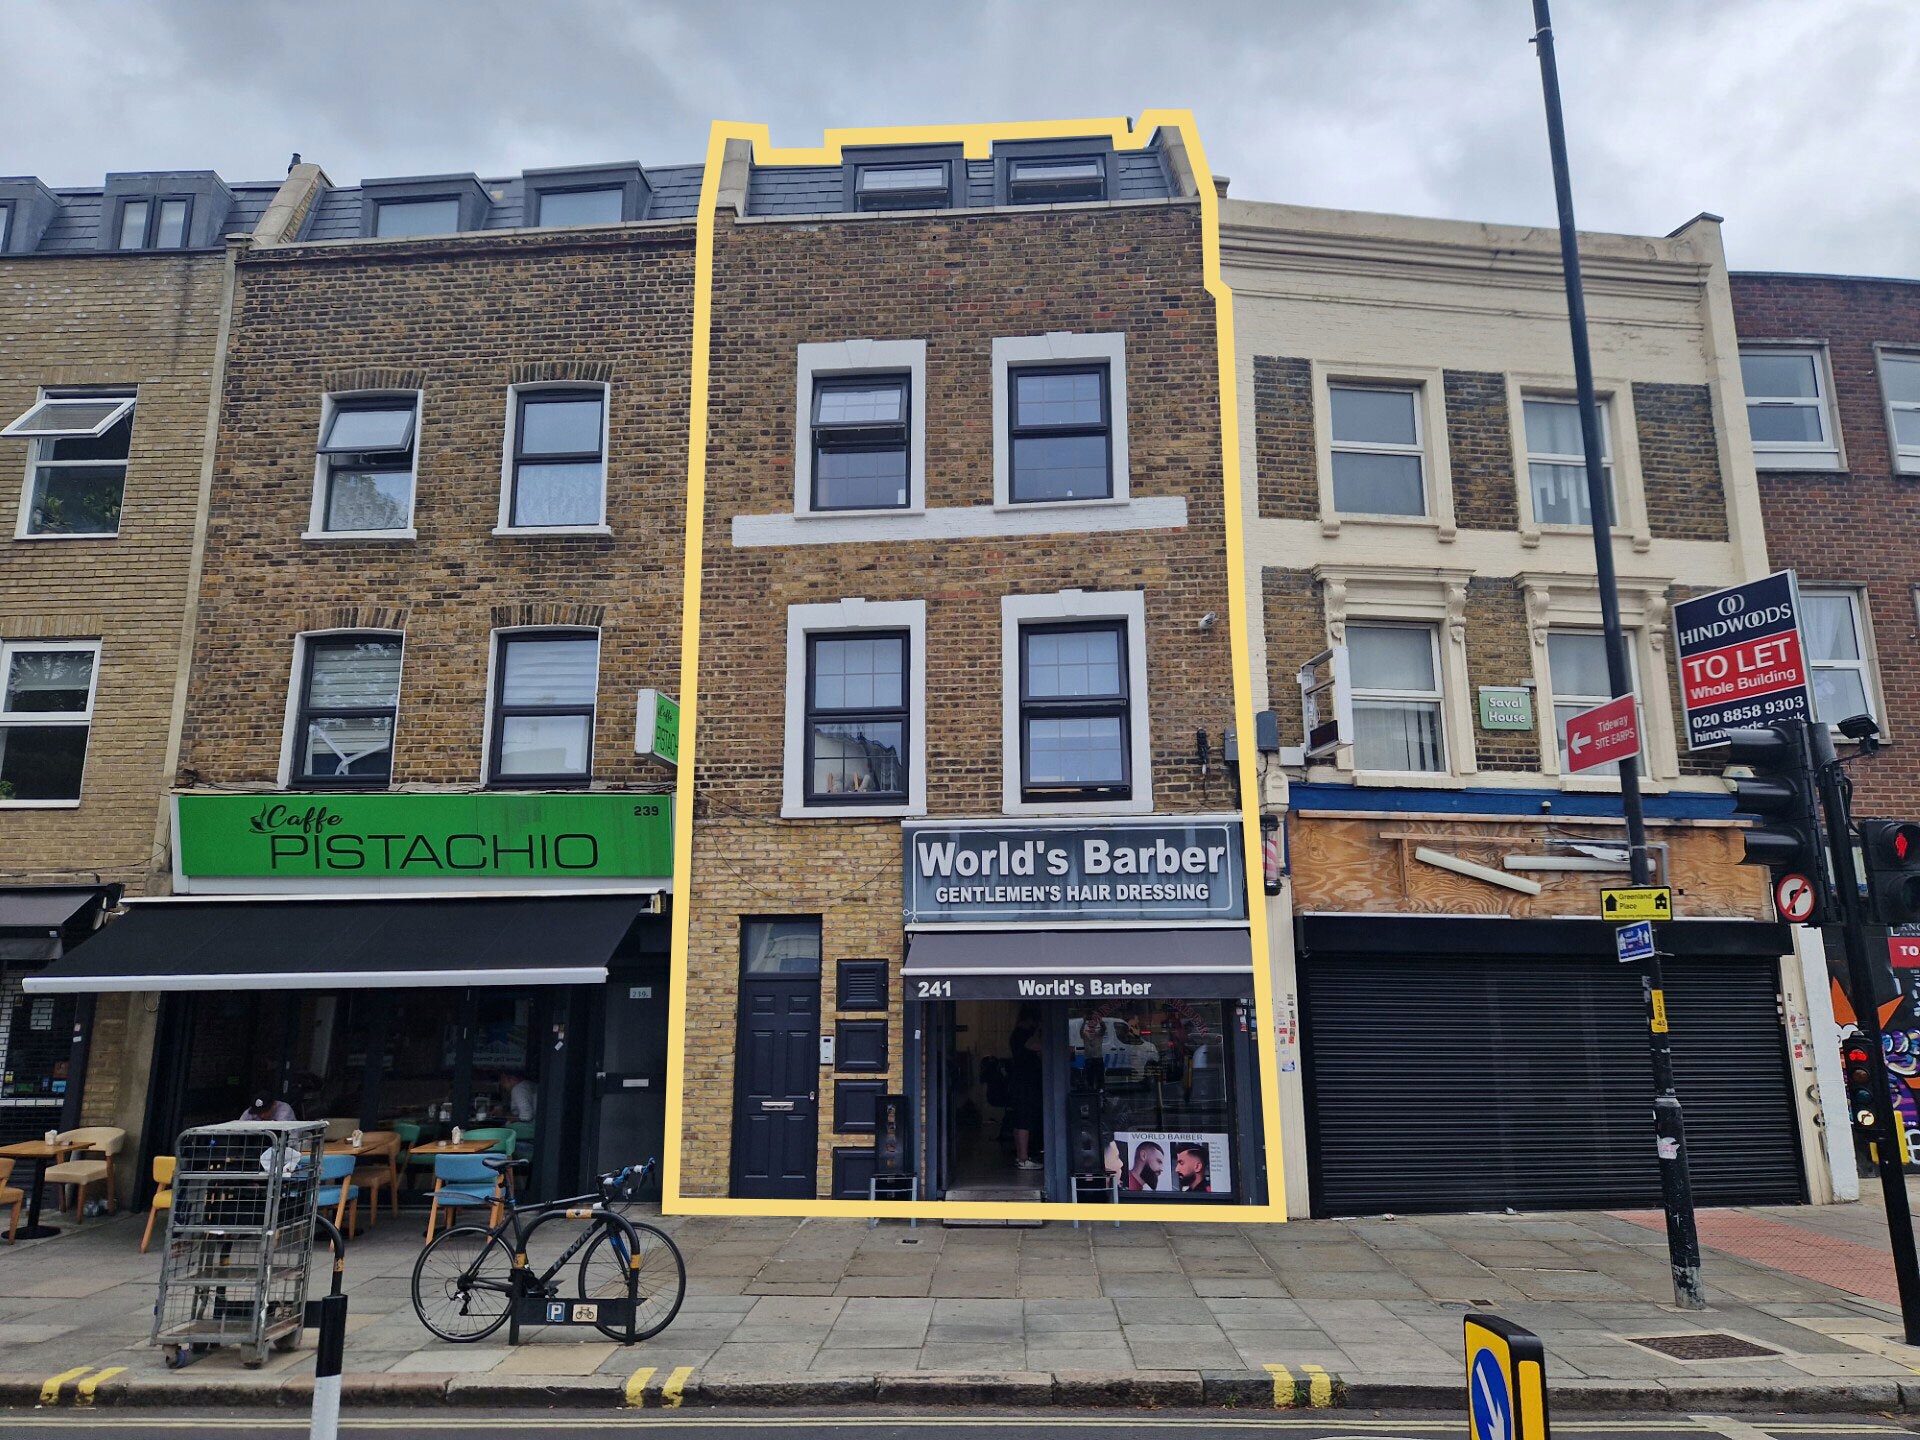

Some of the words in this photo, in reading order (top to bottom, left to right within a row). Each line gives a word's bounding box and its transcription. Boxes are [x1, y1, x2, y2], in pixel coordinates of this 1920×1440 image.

[1680, 603, 1792, 646] HINDWOODS
[1687, 655, 1728, 683] TO
[1736, 637, 1791, 673] LET
[1690, 682, 1735, 700] Whole
[1737, 668, 1797, 691] Building
[1489, 697, 1522, 708] Saval
[1488, 711, 1526, 722] House
[1692, 712, 1720, 729] 020
[1723, 705, 1762, 723] 8858
[1765, 695, 1805, 715] 9303
[1597, 715, 1628, 733] Tideway
[1595, 736, 1610, 750] SITE
[266, 805, 343, 834] Caffe
[634, 806, 659, 816] 239
[270, 834, 598, 869] PISTACHIO
[918, 840, 1069, 877] World's
[1083, 839, 1225, 875] Barber
[935, 885, 1061, 903] GENTLEMEN'S
[1067, 885, 1111, 901] HAIR
[1116, 883, 1209, 900] DRESSING
[1899, 945, 1919, 956] TO
[918, 980, 951, 997] 241
[1018, 980, 1085, 996] World's
[1090, 979, 1152, 996] Barber
[551, 1304, 562, 1320] P
